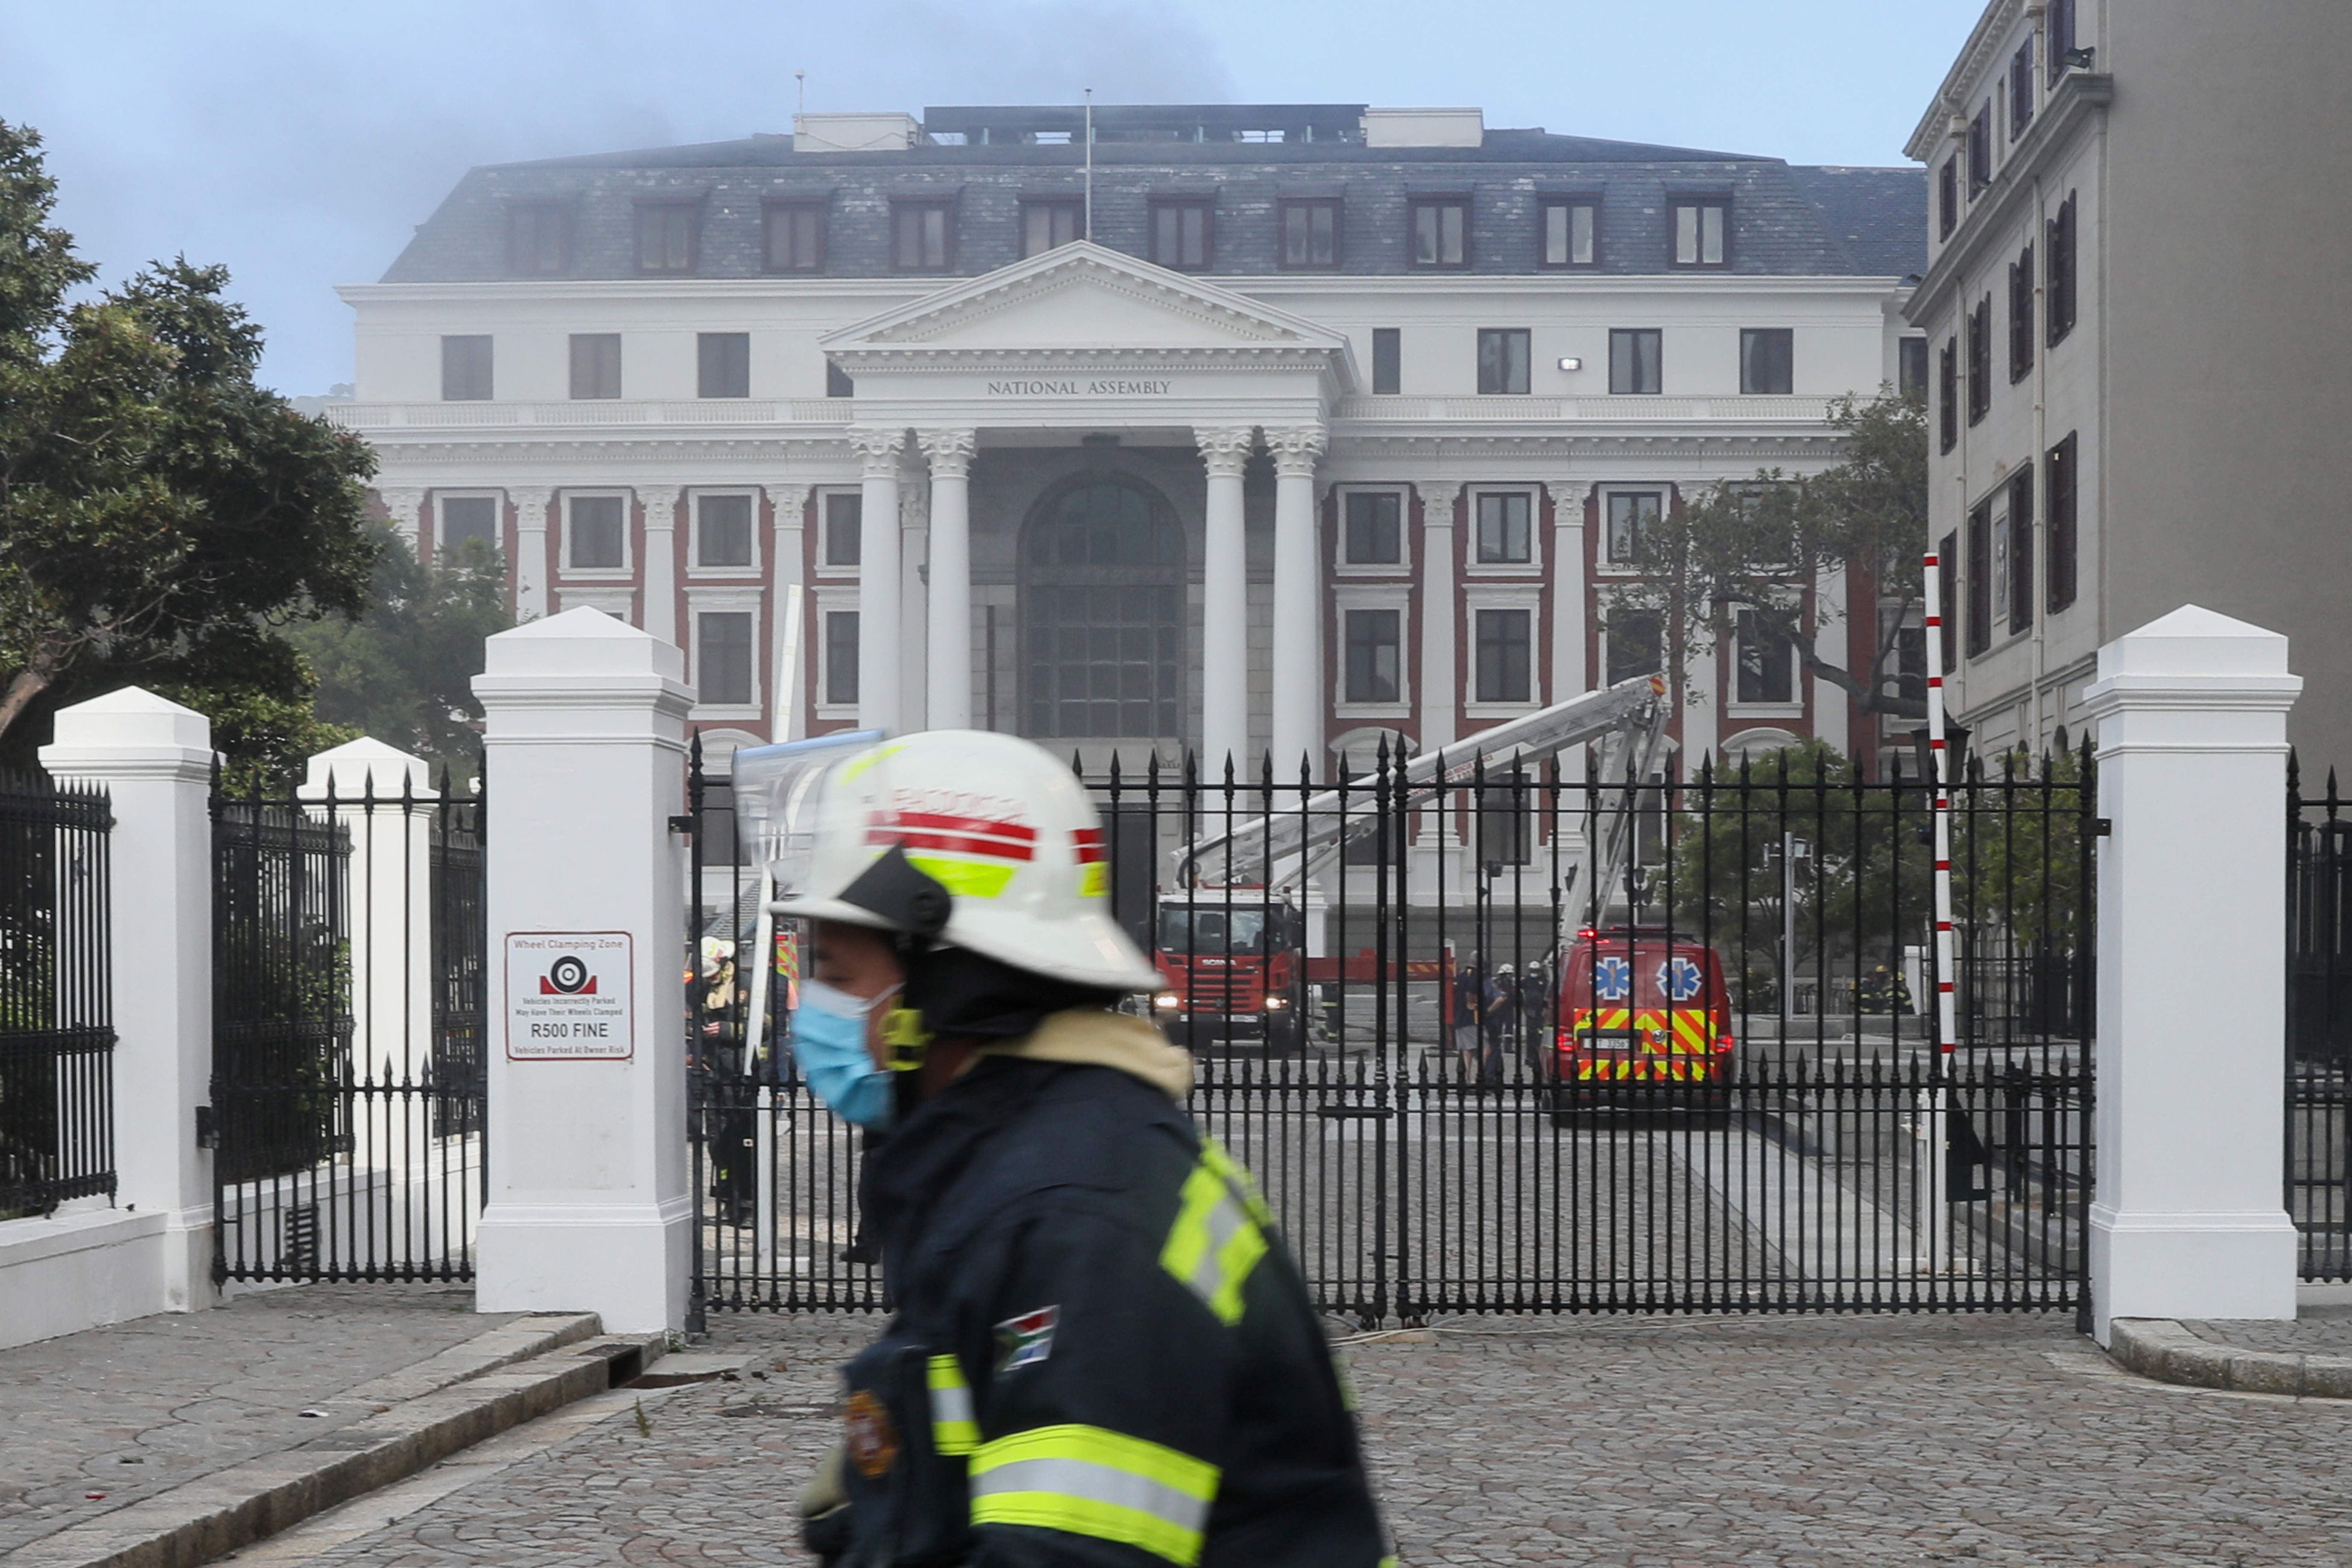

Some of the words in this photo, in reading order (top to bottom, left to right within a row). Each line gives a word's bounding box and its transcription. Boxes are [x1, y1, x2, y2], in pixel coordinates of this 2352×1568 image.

[988, 381, 1079, 394] NATIONAL
[1087, 381, 1171, 394] ASSEMBLY
[514, 940, 545, 948] Wheel
[548, 940, 596, 950] Clamping
[599, 939, 623, 948] Zone
[594, 1008, 623, 1016] Clamped
[531, 1024, 568, 1037] R500
[573, 1023, 608, 1037] FINE
